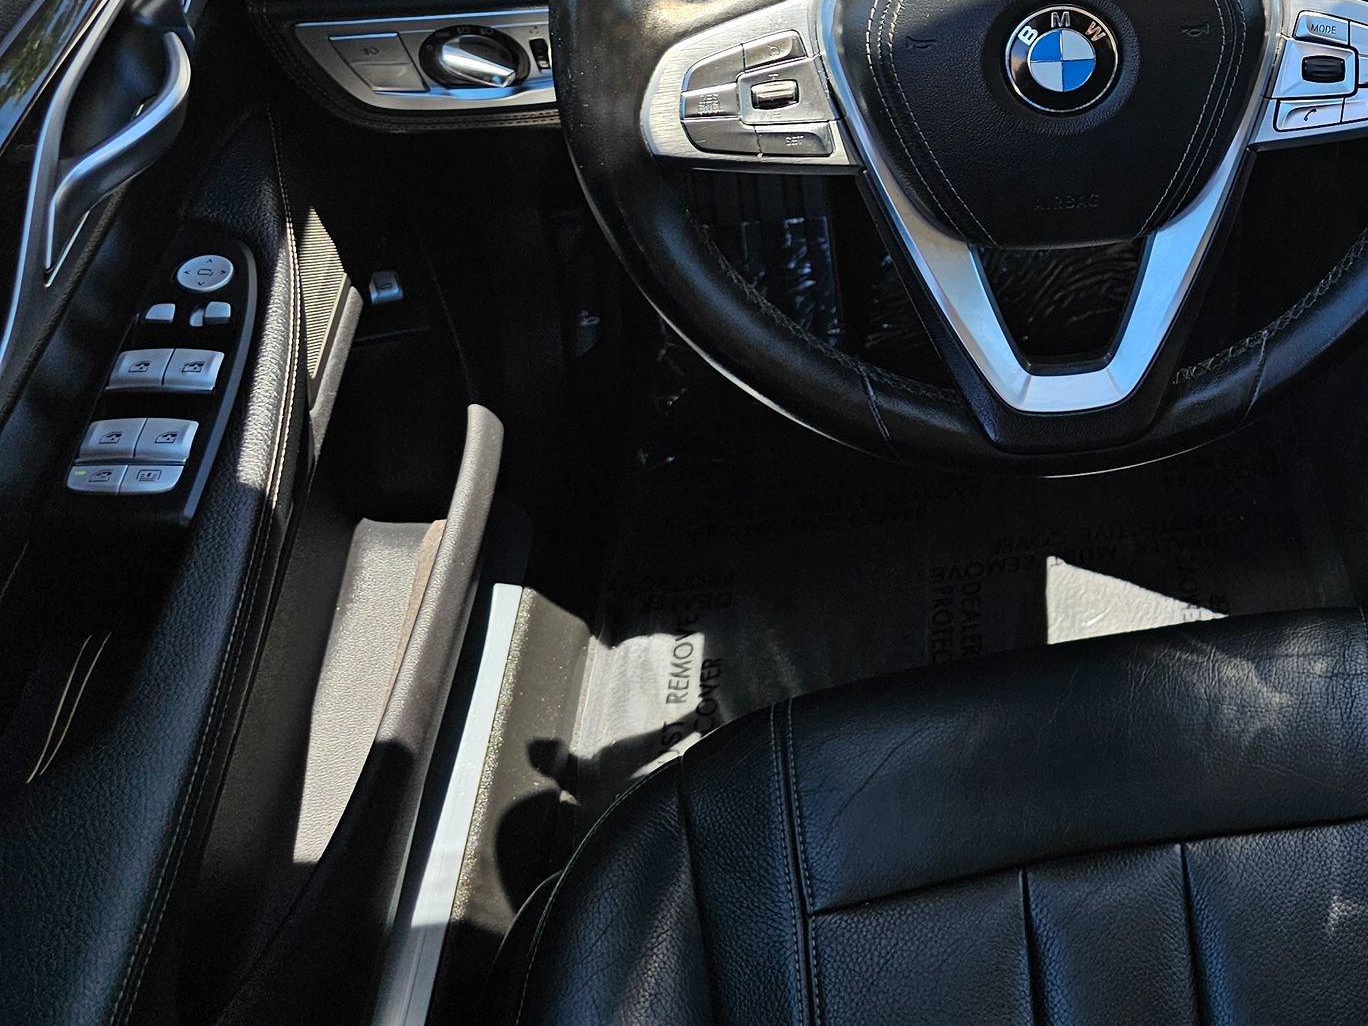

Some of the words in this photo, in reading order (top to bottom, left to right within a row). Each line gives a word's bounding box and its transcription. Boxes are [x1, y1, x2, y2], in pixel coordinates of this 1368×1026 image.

[1018, 11, 1107, 46] BMW
[1310, 23, 1336, 35] MODE
[961, 581, 983, 657] DEALER
[667, 613, 698, 705] REMOVE
